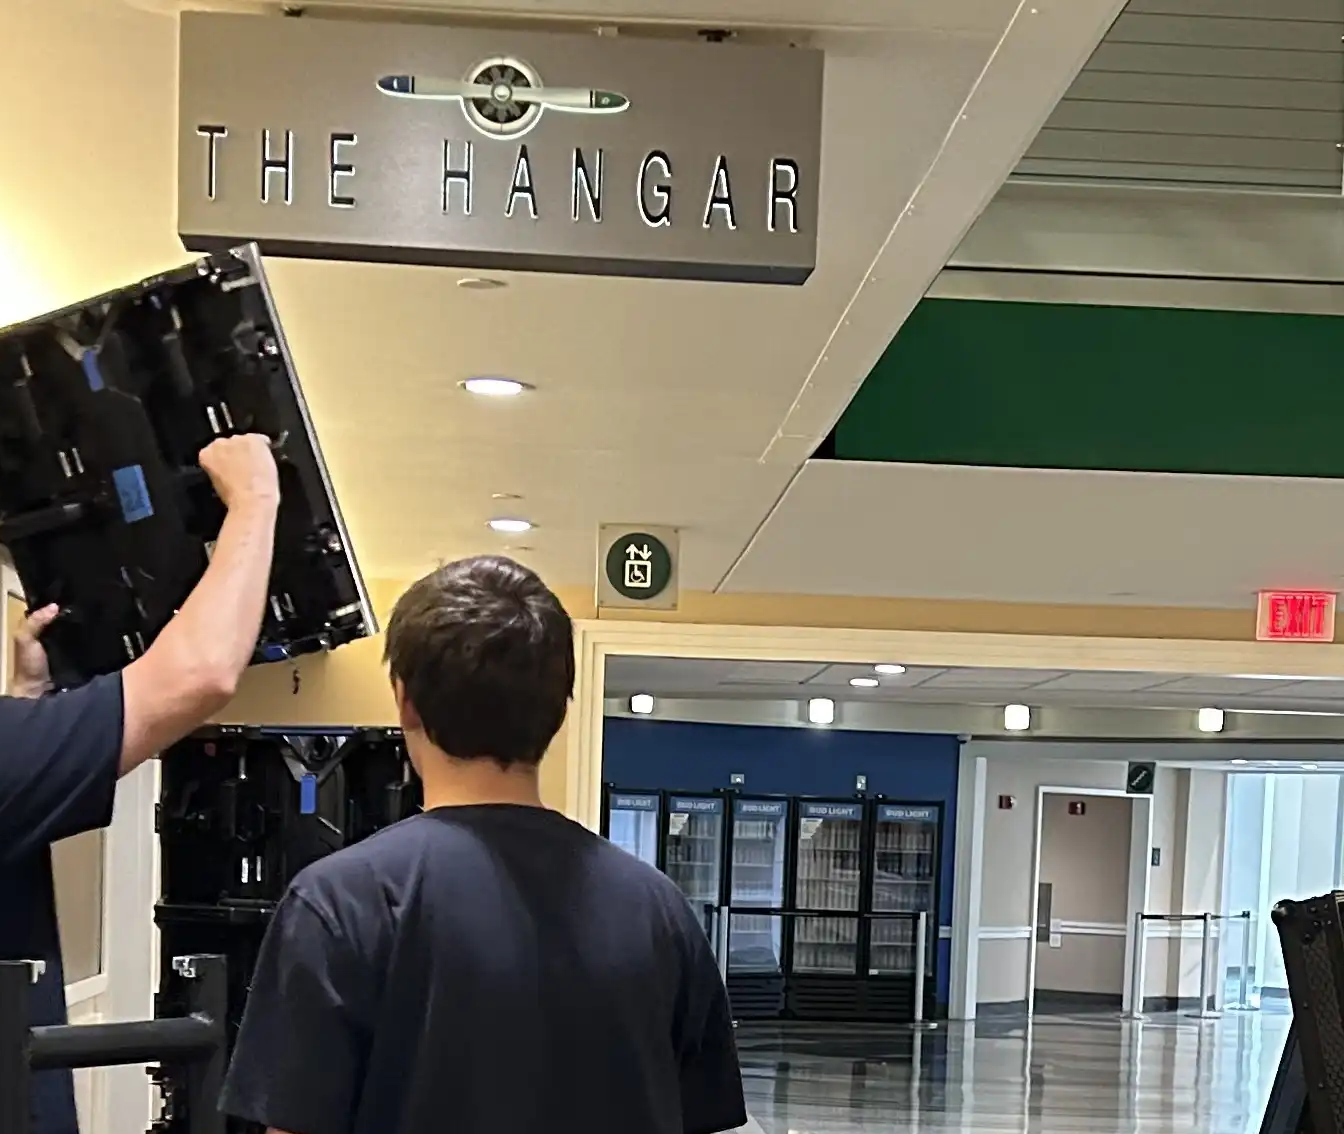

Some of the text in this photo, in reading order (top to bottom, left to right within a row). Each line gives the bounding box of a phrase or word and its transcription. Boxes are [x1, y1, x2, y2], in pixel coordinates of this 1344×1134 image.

[196, 124, 800, 234] THE HANGAR
[1268, 595, 1329, 637] EXIT
